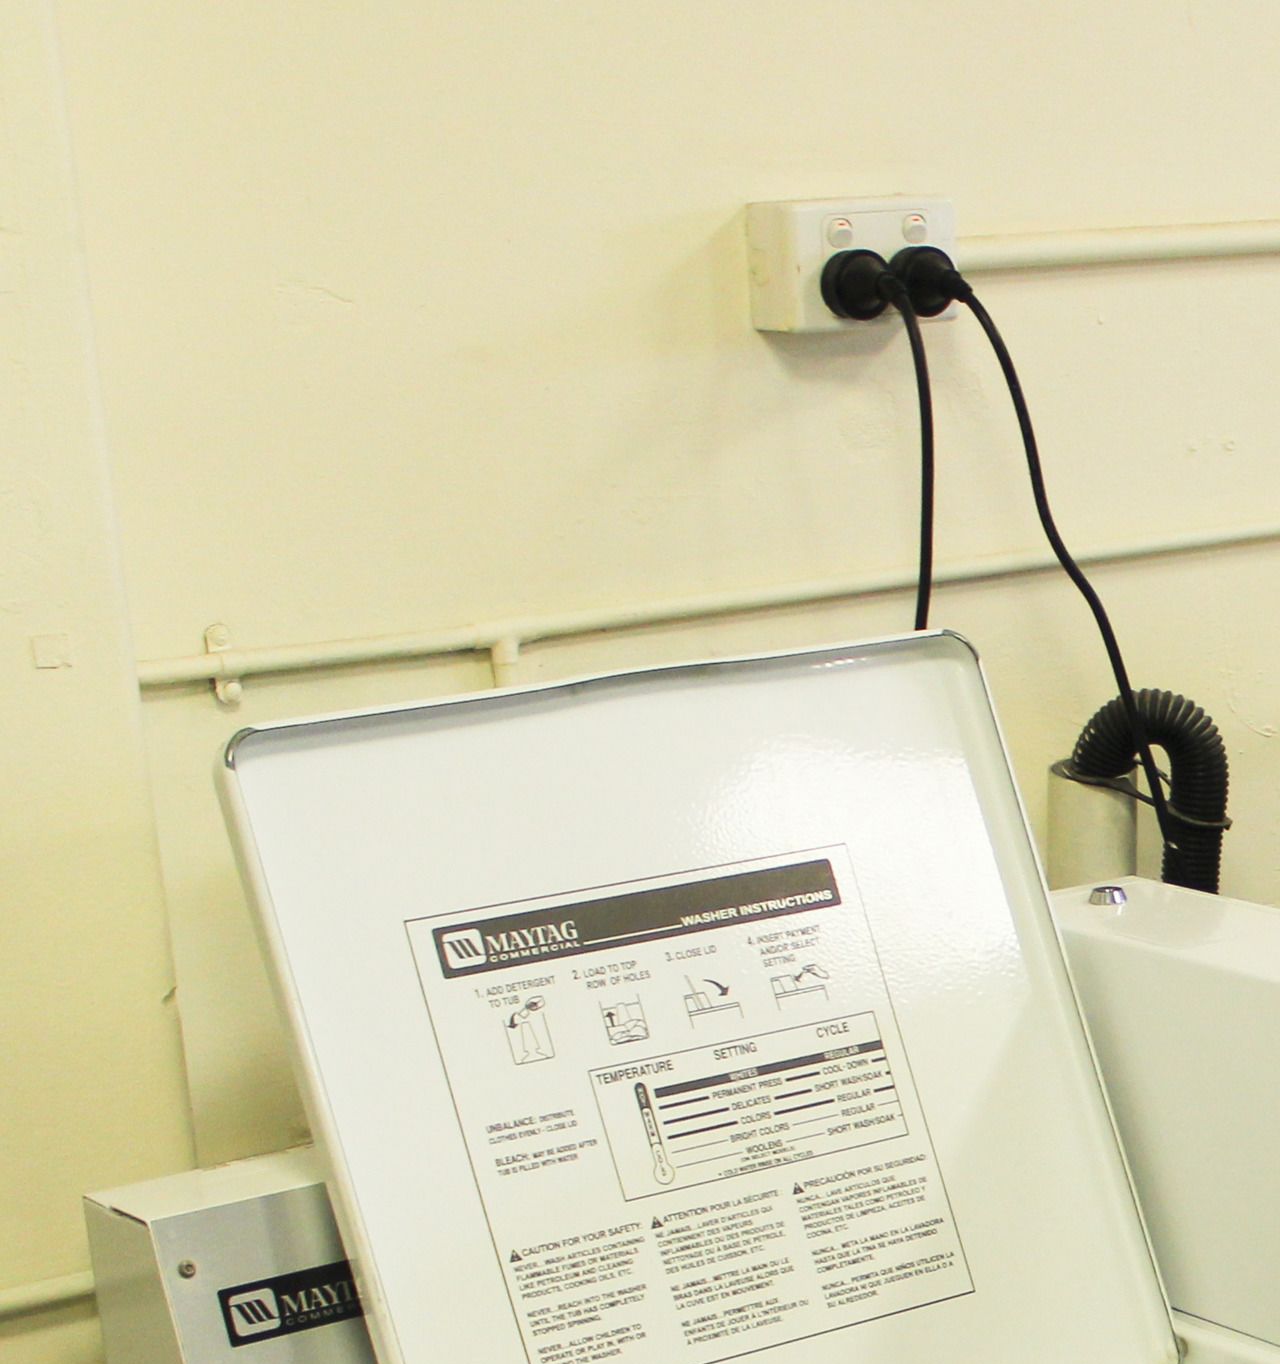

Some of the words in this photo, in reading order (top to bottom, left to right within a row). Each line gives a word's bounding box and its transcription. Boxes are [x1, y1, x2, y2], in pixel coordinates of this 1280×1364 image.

[680, 906, 738, 927] WASHER
[739, 889, 833, 916] INSTRUCTIONS
[483, 918, 579, 955] MAYTAG
[488, 939, 581, 963] COMMERCIAL
[814, 1021, 850, 1038] CYCLE
[712, 1041, 758, 1060] SETTING
[595, 1059, 674, 1085] TEMPERATURE
[521, 1240, 561, 1257] CAUTION
[561, 1236, 580, 1247] FOR
[582, 1229, 606, 1242] YOUR
[281, 1280, 353, 1316] MAYT
